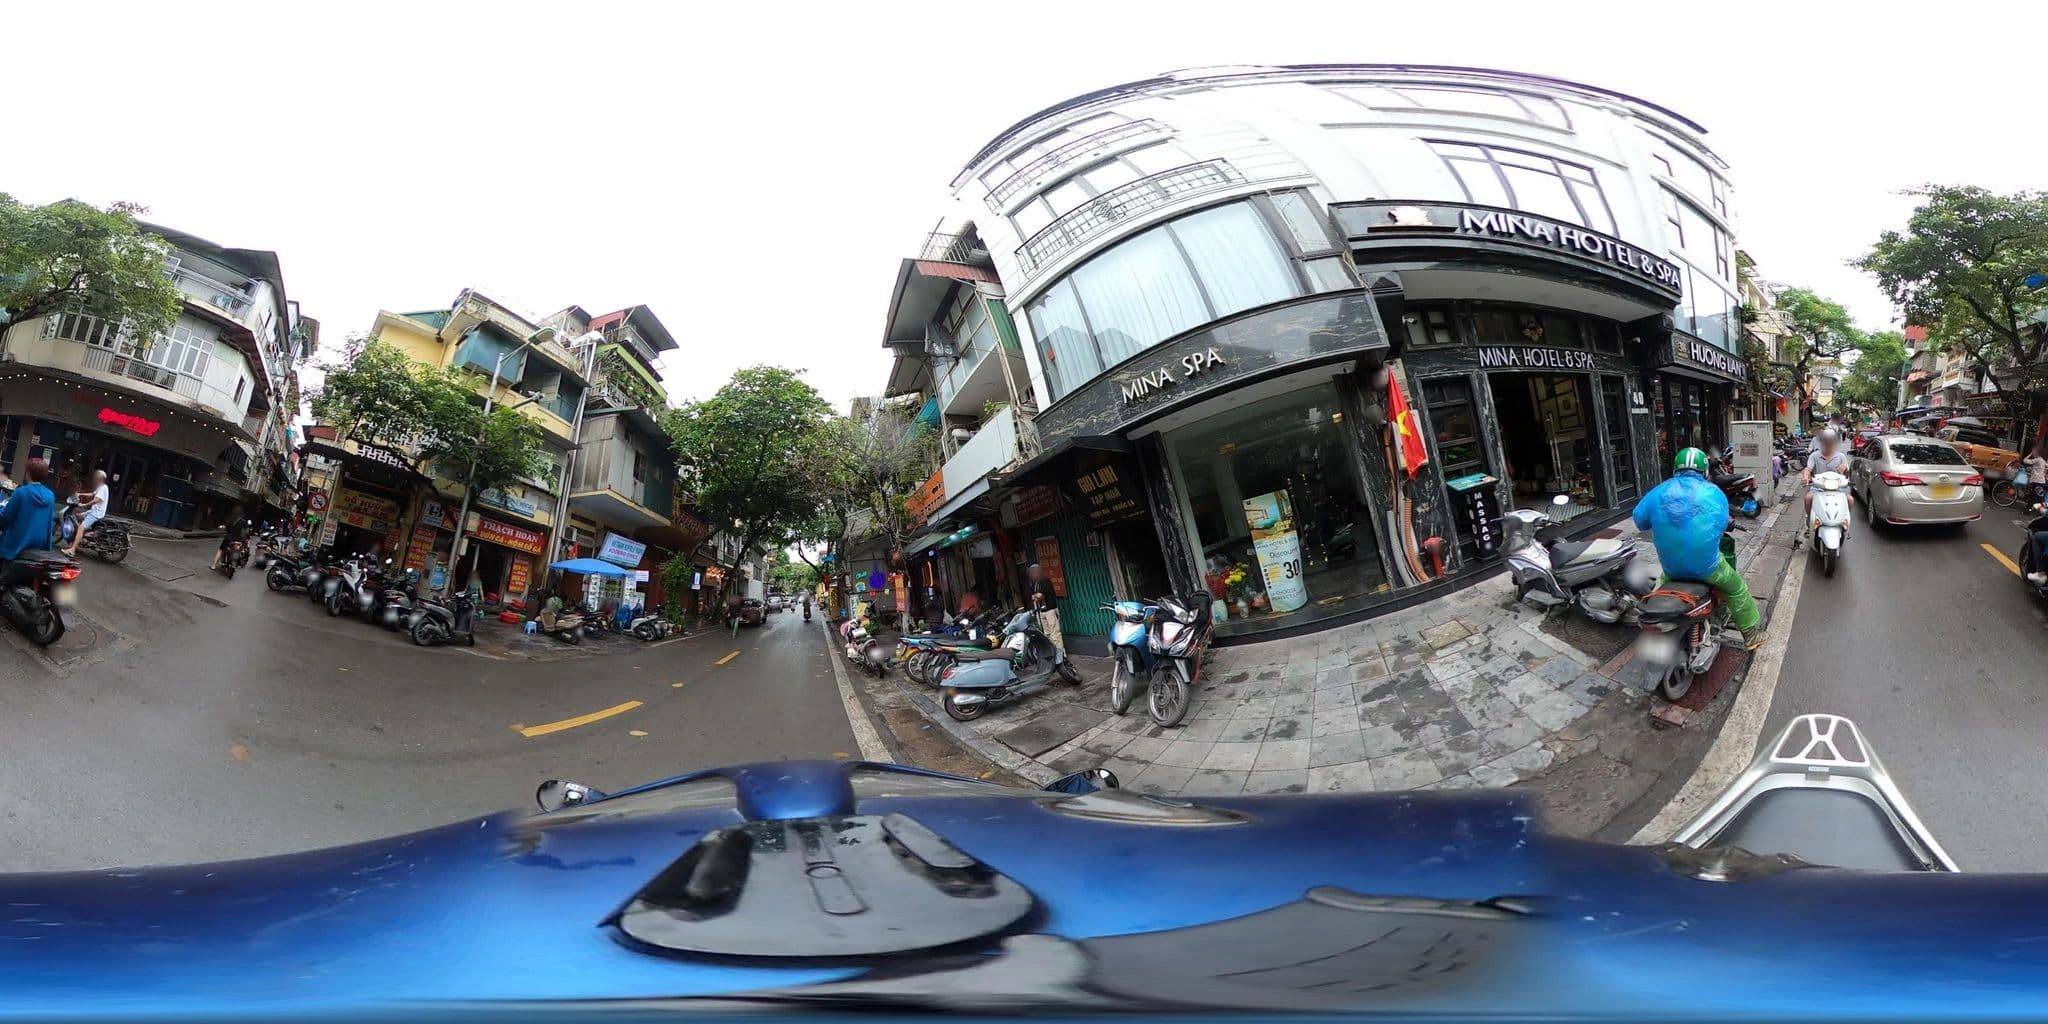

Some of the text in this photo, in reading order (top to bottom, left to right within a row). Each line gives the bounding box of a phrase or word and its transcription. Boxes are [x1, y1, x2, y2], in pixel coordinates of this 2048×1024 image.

[1461, 208, 1682, 290] MINA HOTEL & SPA
[1479, 346, 1596, 370] MINA HOTEL & SPA
[1121, 346, 1226, 405] MINA SPA
[1633, 391, 1645, 406] 40
[483, 520, 514, 536] THẠCH
